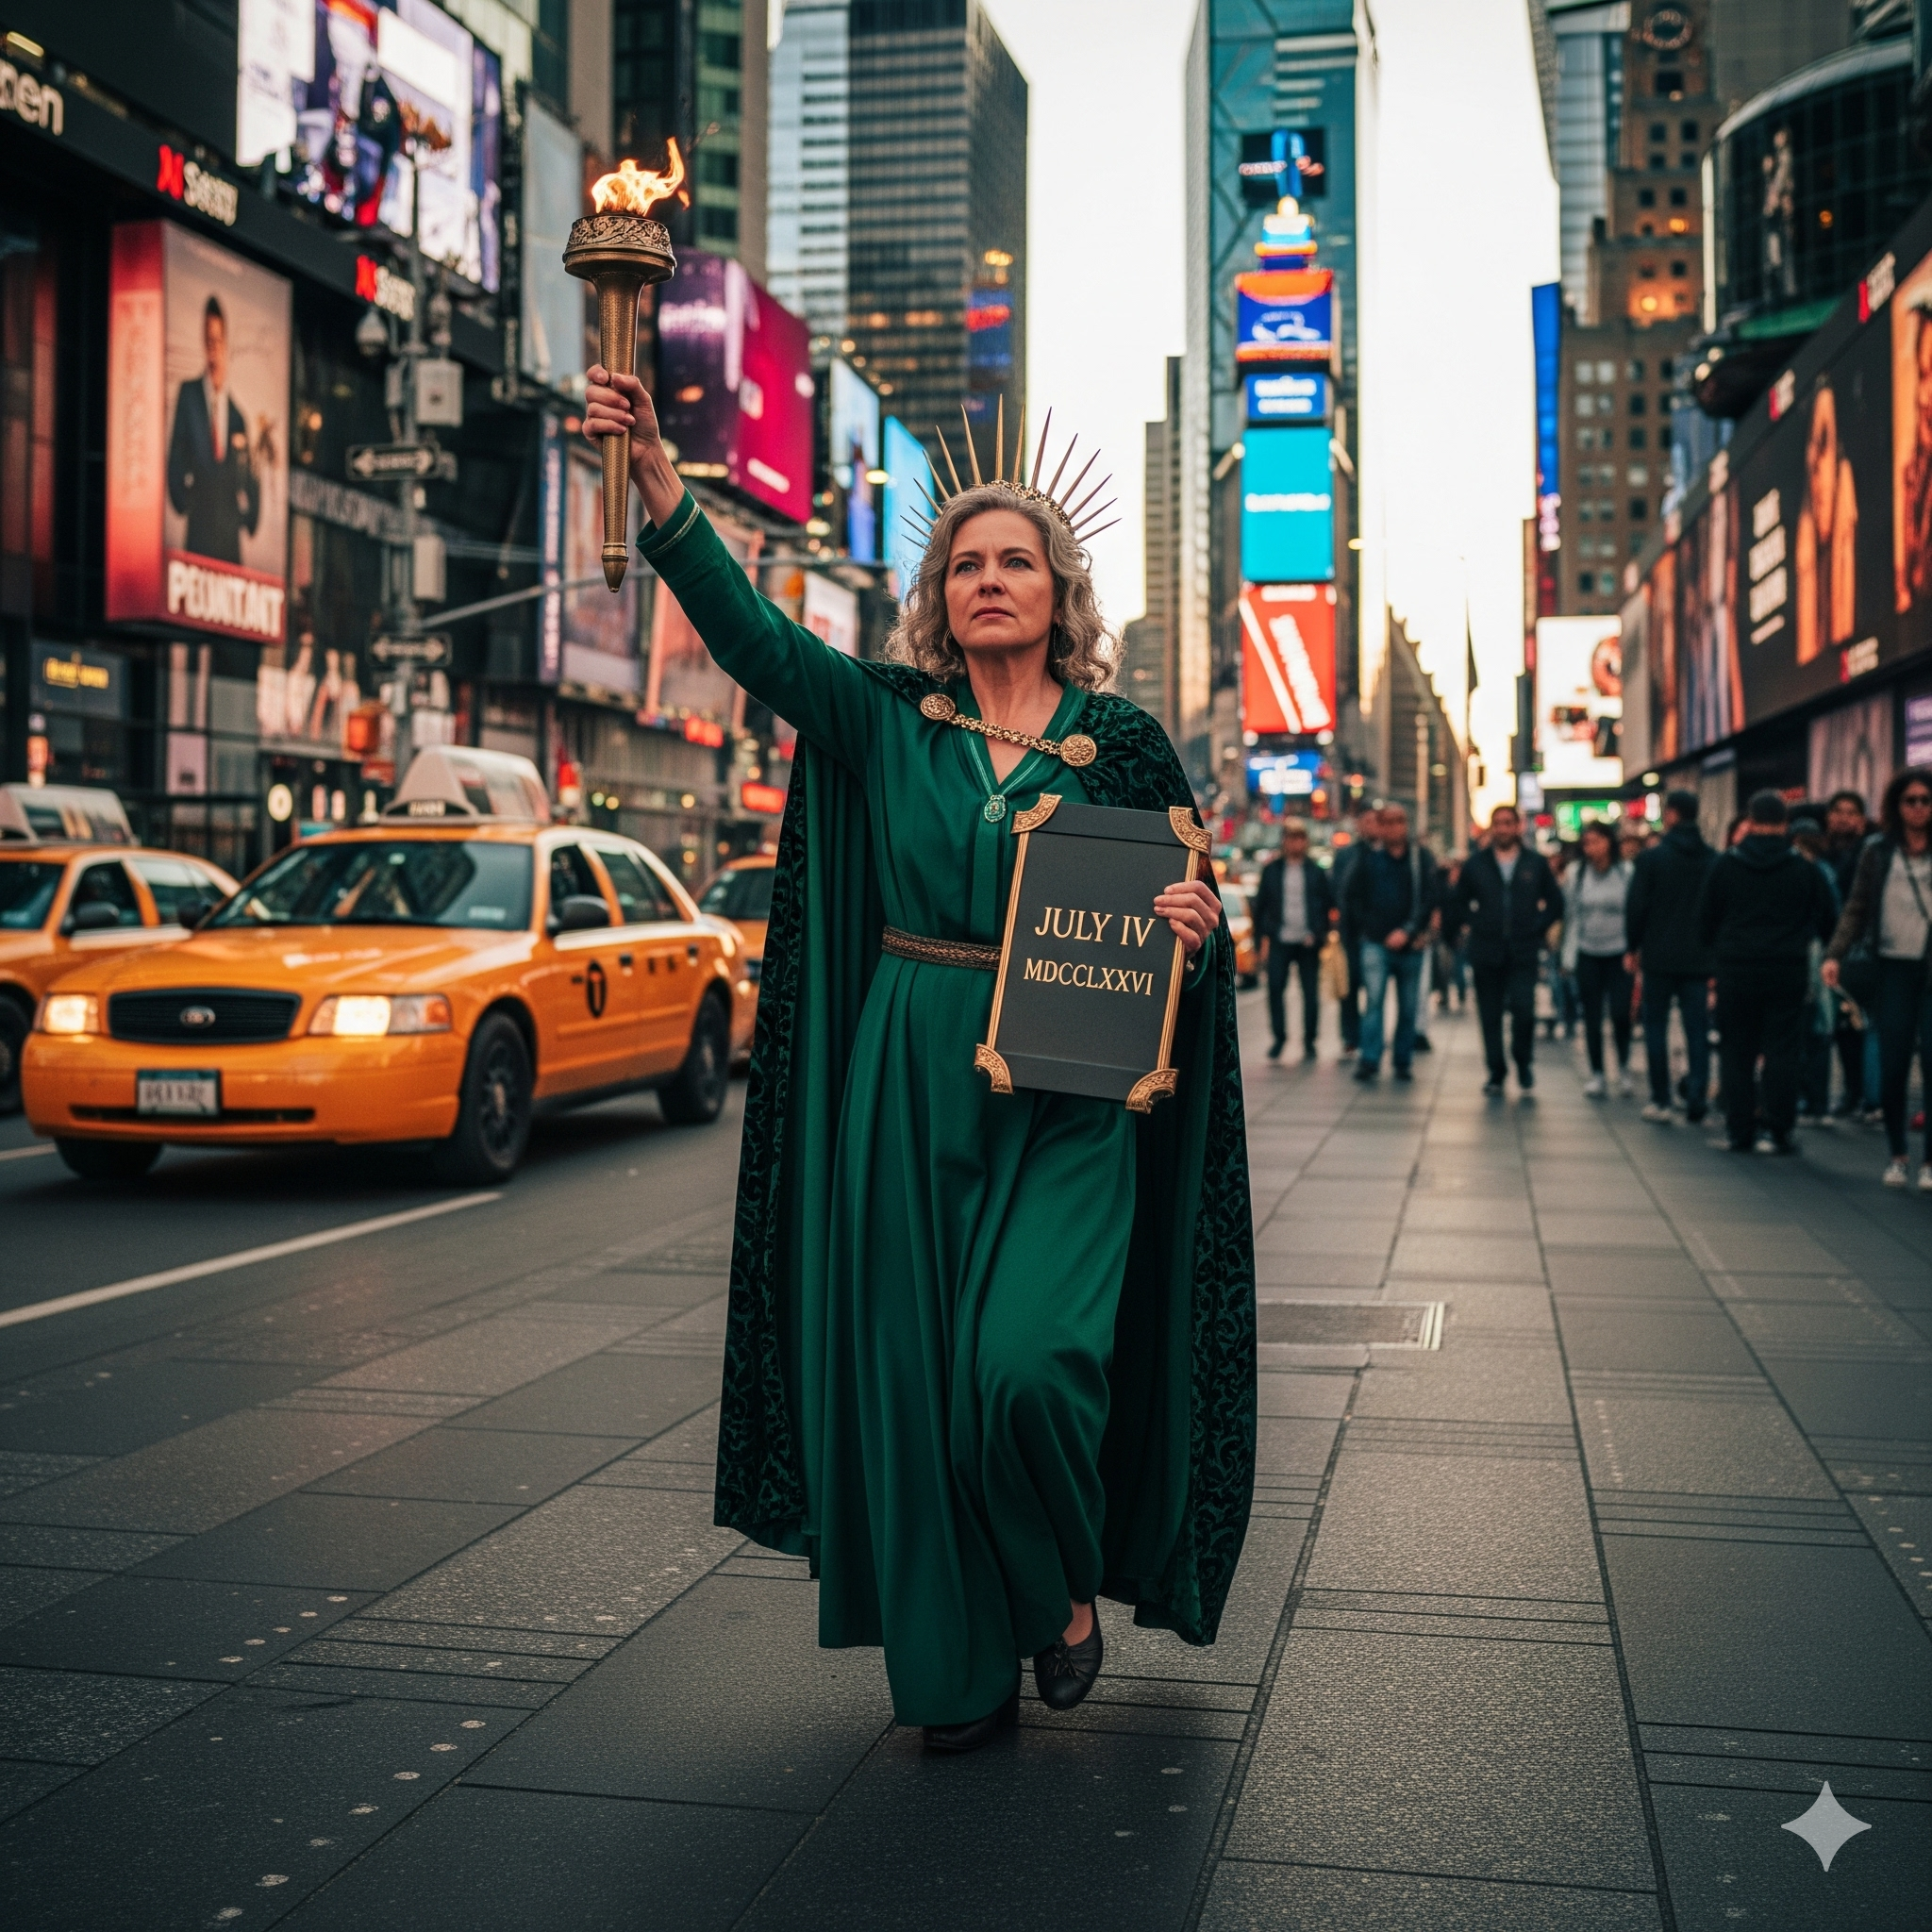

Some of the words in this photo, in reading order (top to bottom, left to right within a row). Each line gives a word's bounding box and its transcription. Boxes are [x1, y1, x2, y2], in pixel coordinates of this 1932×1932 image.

[1034, 907, 1113, 942] JULY
[1120, 915, 1157, 948] IV
[1023, 958, 1154, 996] MDCCLXXVI
